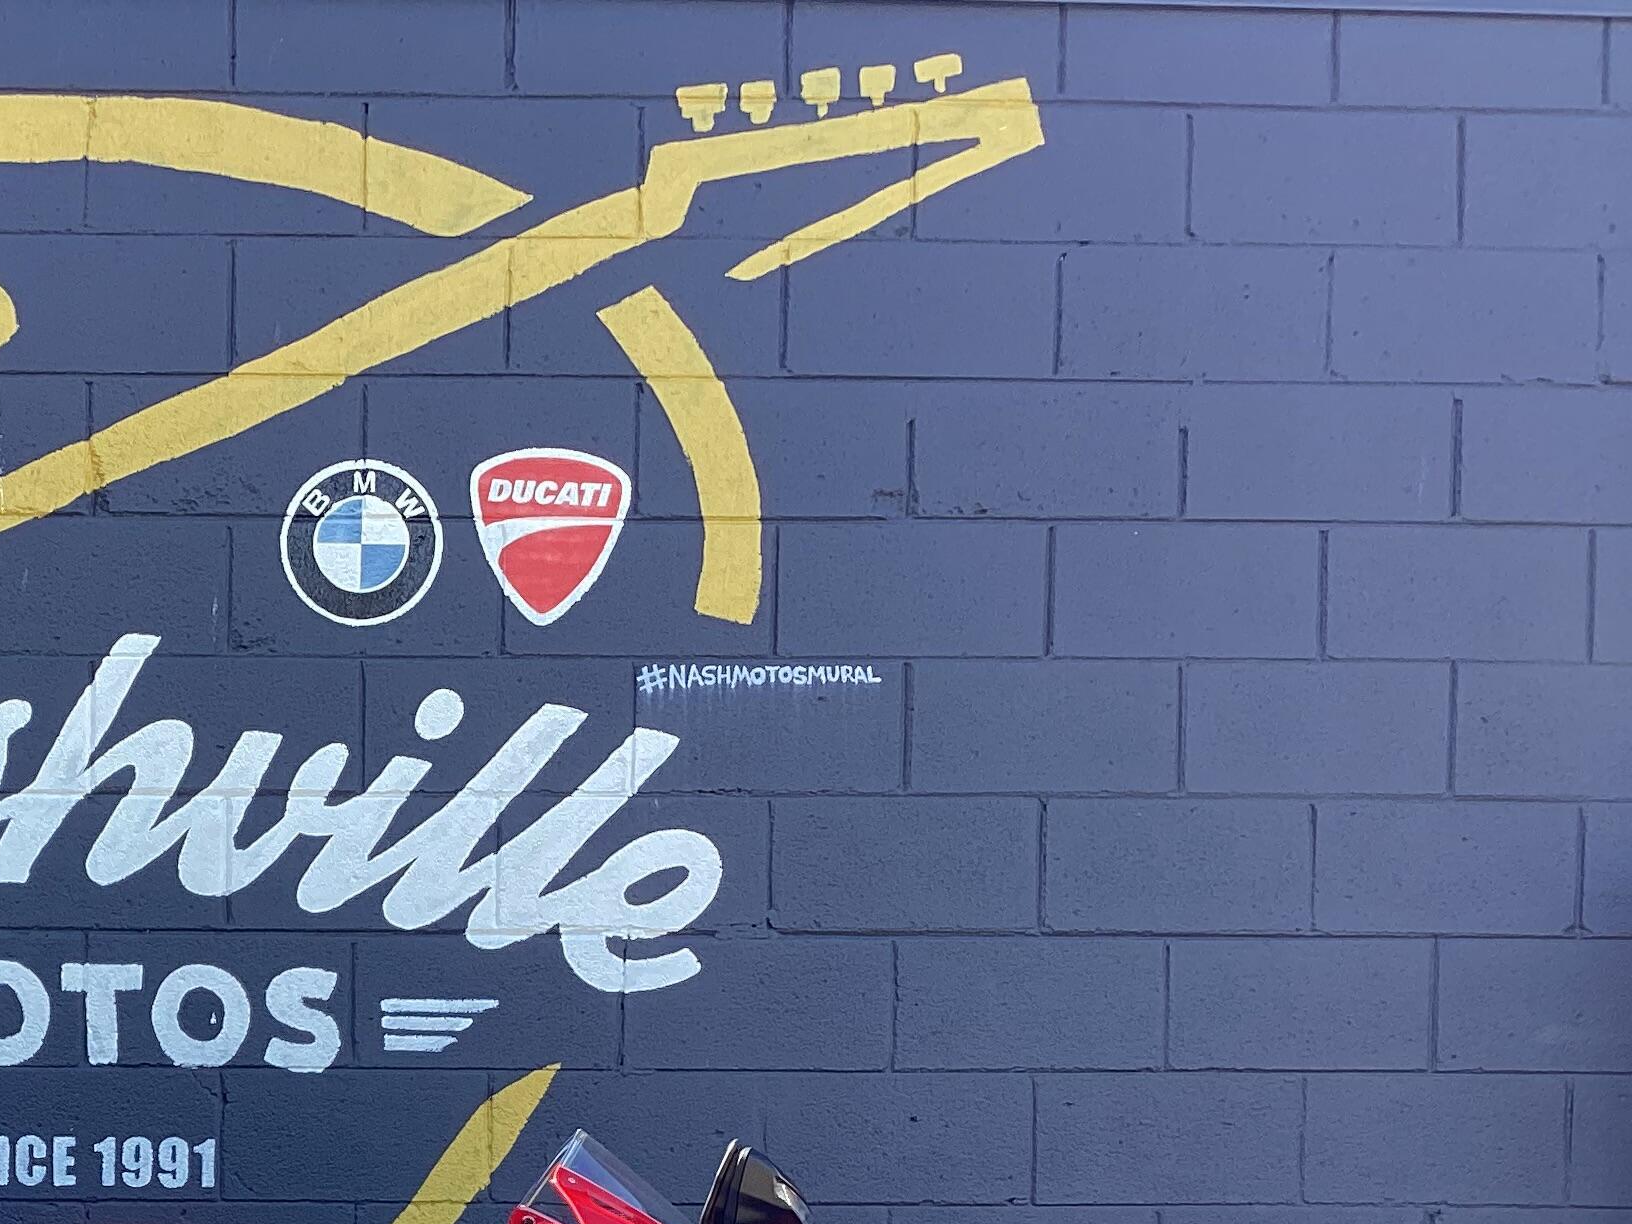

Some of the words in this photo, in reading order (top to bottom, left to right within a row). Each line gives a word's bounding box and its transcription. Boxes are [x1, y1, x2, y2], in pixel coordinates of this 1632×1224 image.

[302, 471, 425, 518] BMW
[487, 477, 613, 508] DUCATI
[636, 663, 882, 694] #NASHMOTOSMURAL
[94, 1136, 218, 1190] 1991
